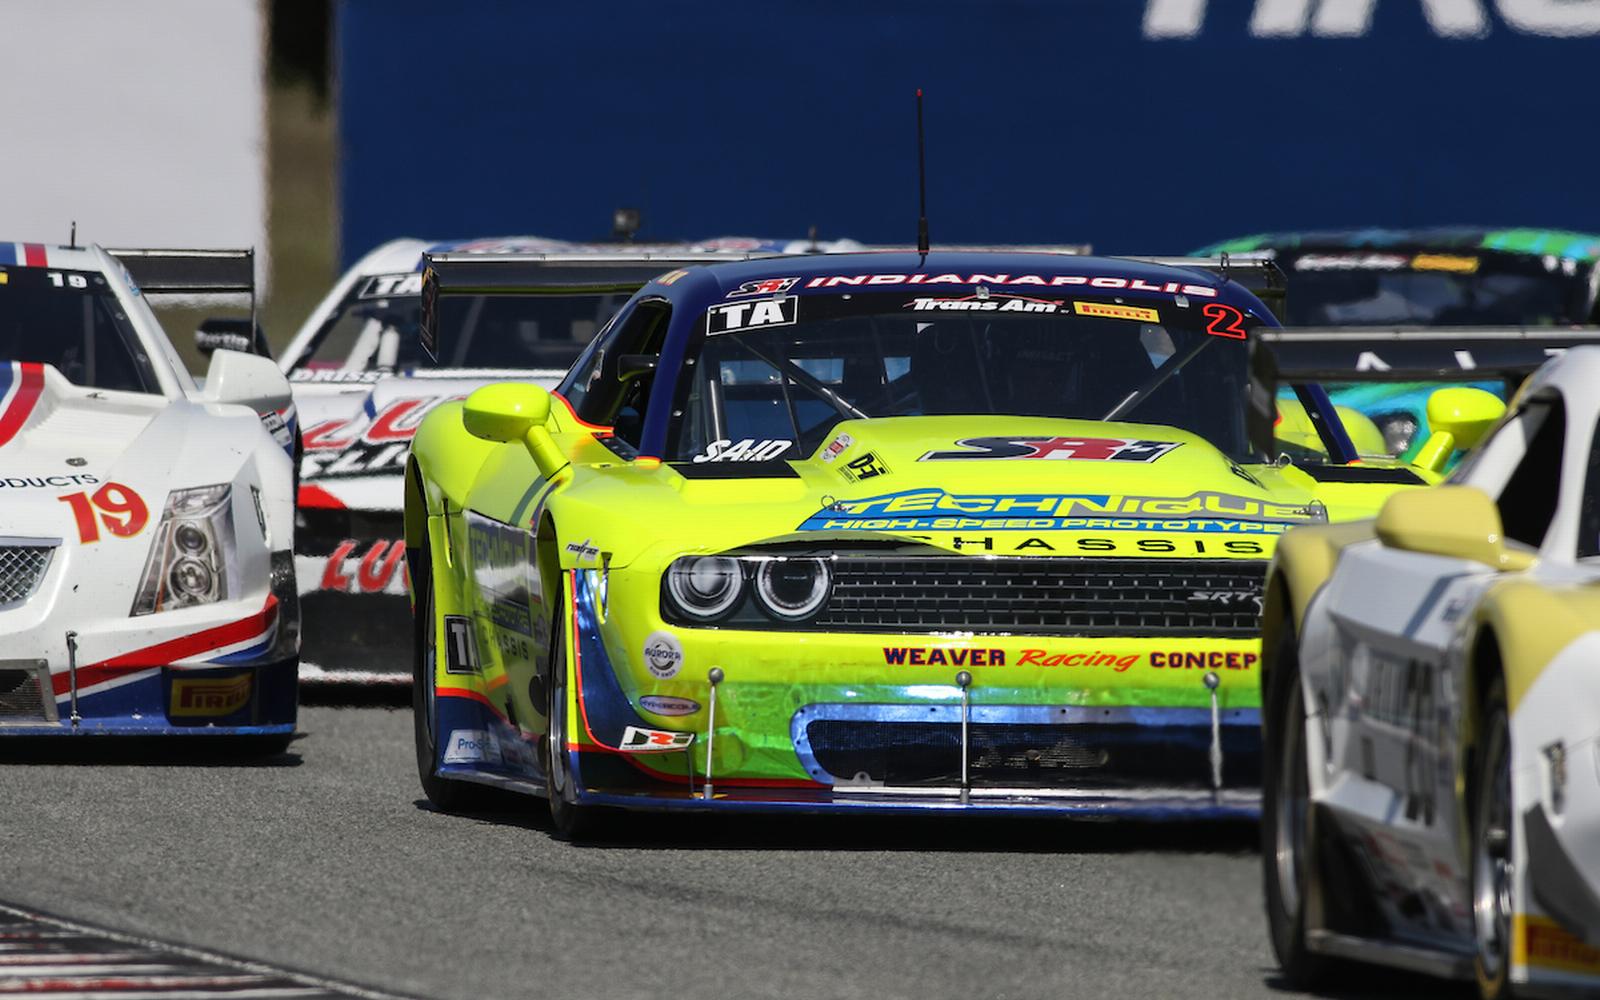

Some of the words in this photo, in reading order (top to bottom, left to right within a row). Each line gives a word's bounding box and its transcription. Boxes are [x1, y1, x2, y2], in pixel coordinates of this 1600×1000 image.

[48, 272, 88, 288] 19
[804, 274, 1218, 297] INDIANAPOLIS
[719, 299, 786, 329] TA
[914, 298, 1006, 312] Trans
[1006, 299, 1057, 314] Am
[1203, 303, 1247, 339] 2
[693, 438, 793, 464] SAID
[58, 481, 150, 544] 19
[839, 493, 1312, 518] TECHNIQUE
[822, 519, 1056, 530] HIGH-SPEED
[321, 539, 410, 592] LU
[1187, 591, 1256, 604] SRT
[883, 648, 1005, 666] WEAVER
[1015, 649, 1141, 672] Racing
[1149, 651, 1262, 670] CONCEP
